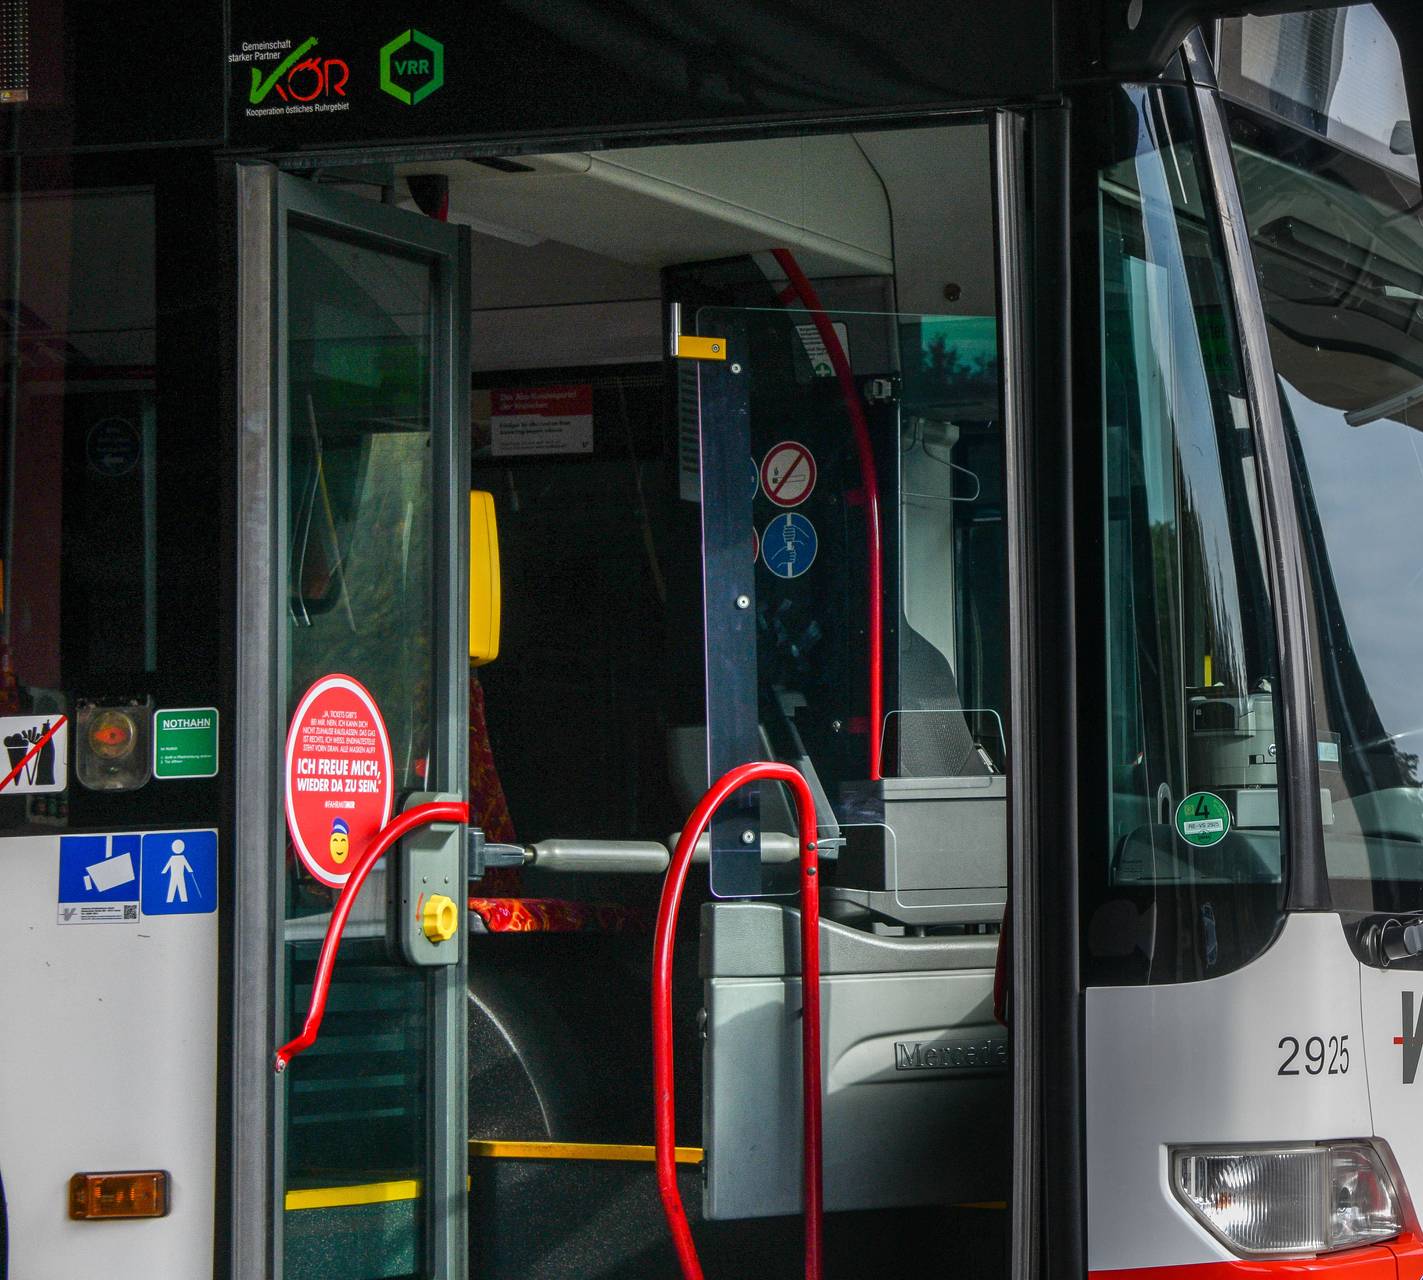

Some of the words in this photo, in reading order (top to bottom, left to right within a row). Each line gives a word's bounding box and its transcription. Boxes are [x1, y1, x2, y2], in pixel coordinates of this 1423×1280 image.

[242, 39, 291, 52] Gemeinschaft
[228, 52, 251, 63] starker
[254, 50, 281, 62] Partner
[394, 59, 430, 75] VRR
[245, 106, 285, 117] Kooperation
[285, 104, 313, 115] östliches
[314, 102, 350, 114] Ruhrgebiet
[163, 717, 211, 729] NOTHAHN
[297, 758, 316, 774] ICH
[318, 759, 349, 775] FREUE
[351, 760, 381, 779] MICH,
[297, 778, 329, 792] WIEDER
[331, 779, 343, 792] DA
[344, 779, 357, 792] ZU
[1194, 796, 1210, 819] 4
[1277, 1034, 1350, 1076] 2925
